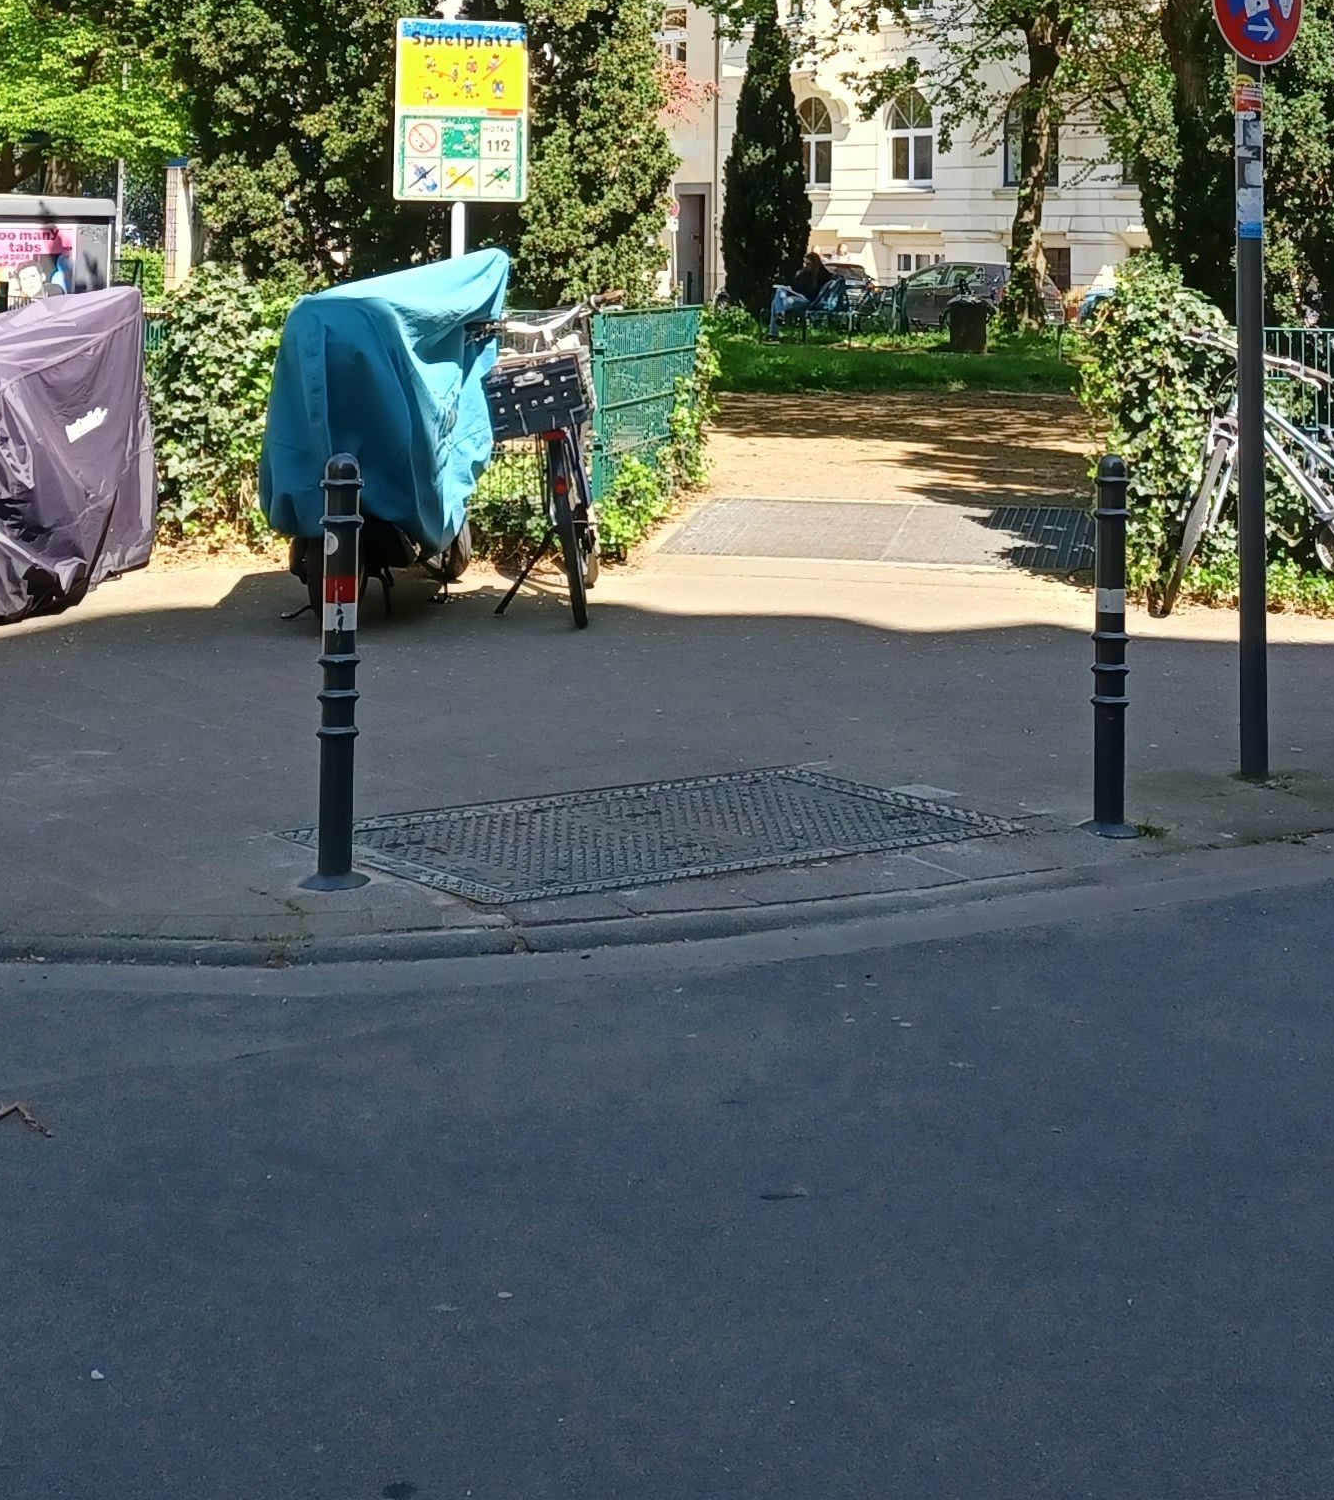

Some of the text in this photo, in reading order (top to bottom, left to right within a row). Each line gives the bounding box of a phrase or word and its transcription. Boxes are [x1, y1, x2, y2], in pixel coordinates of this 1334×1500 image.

[411, 31, 513, 49] Spielplatz
[487, 139, 511, 152] 112
[19, 228, 59, 241] many
[8, 242, 42, 253] tabs
